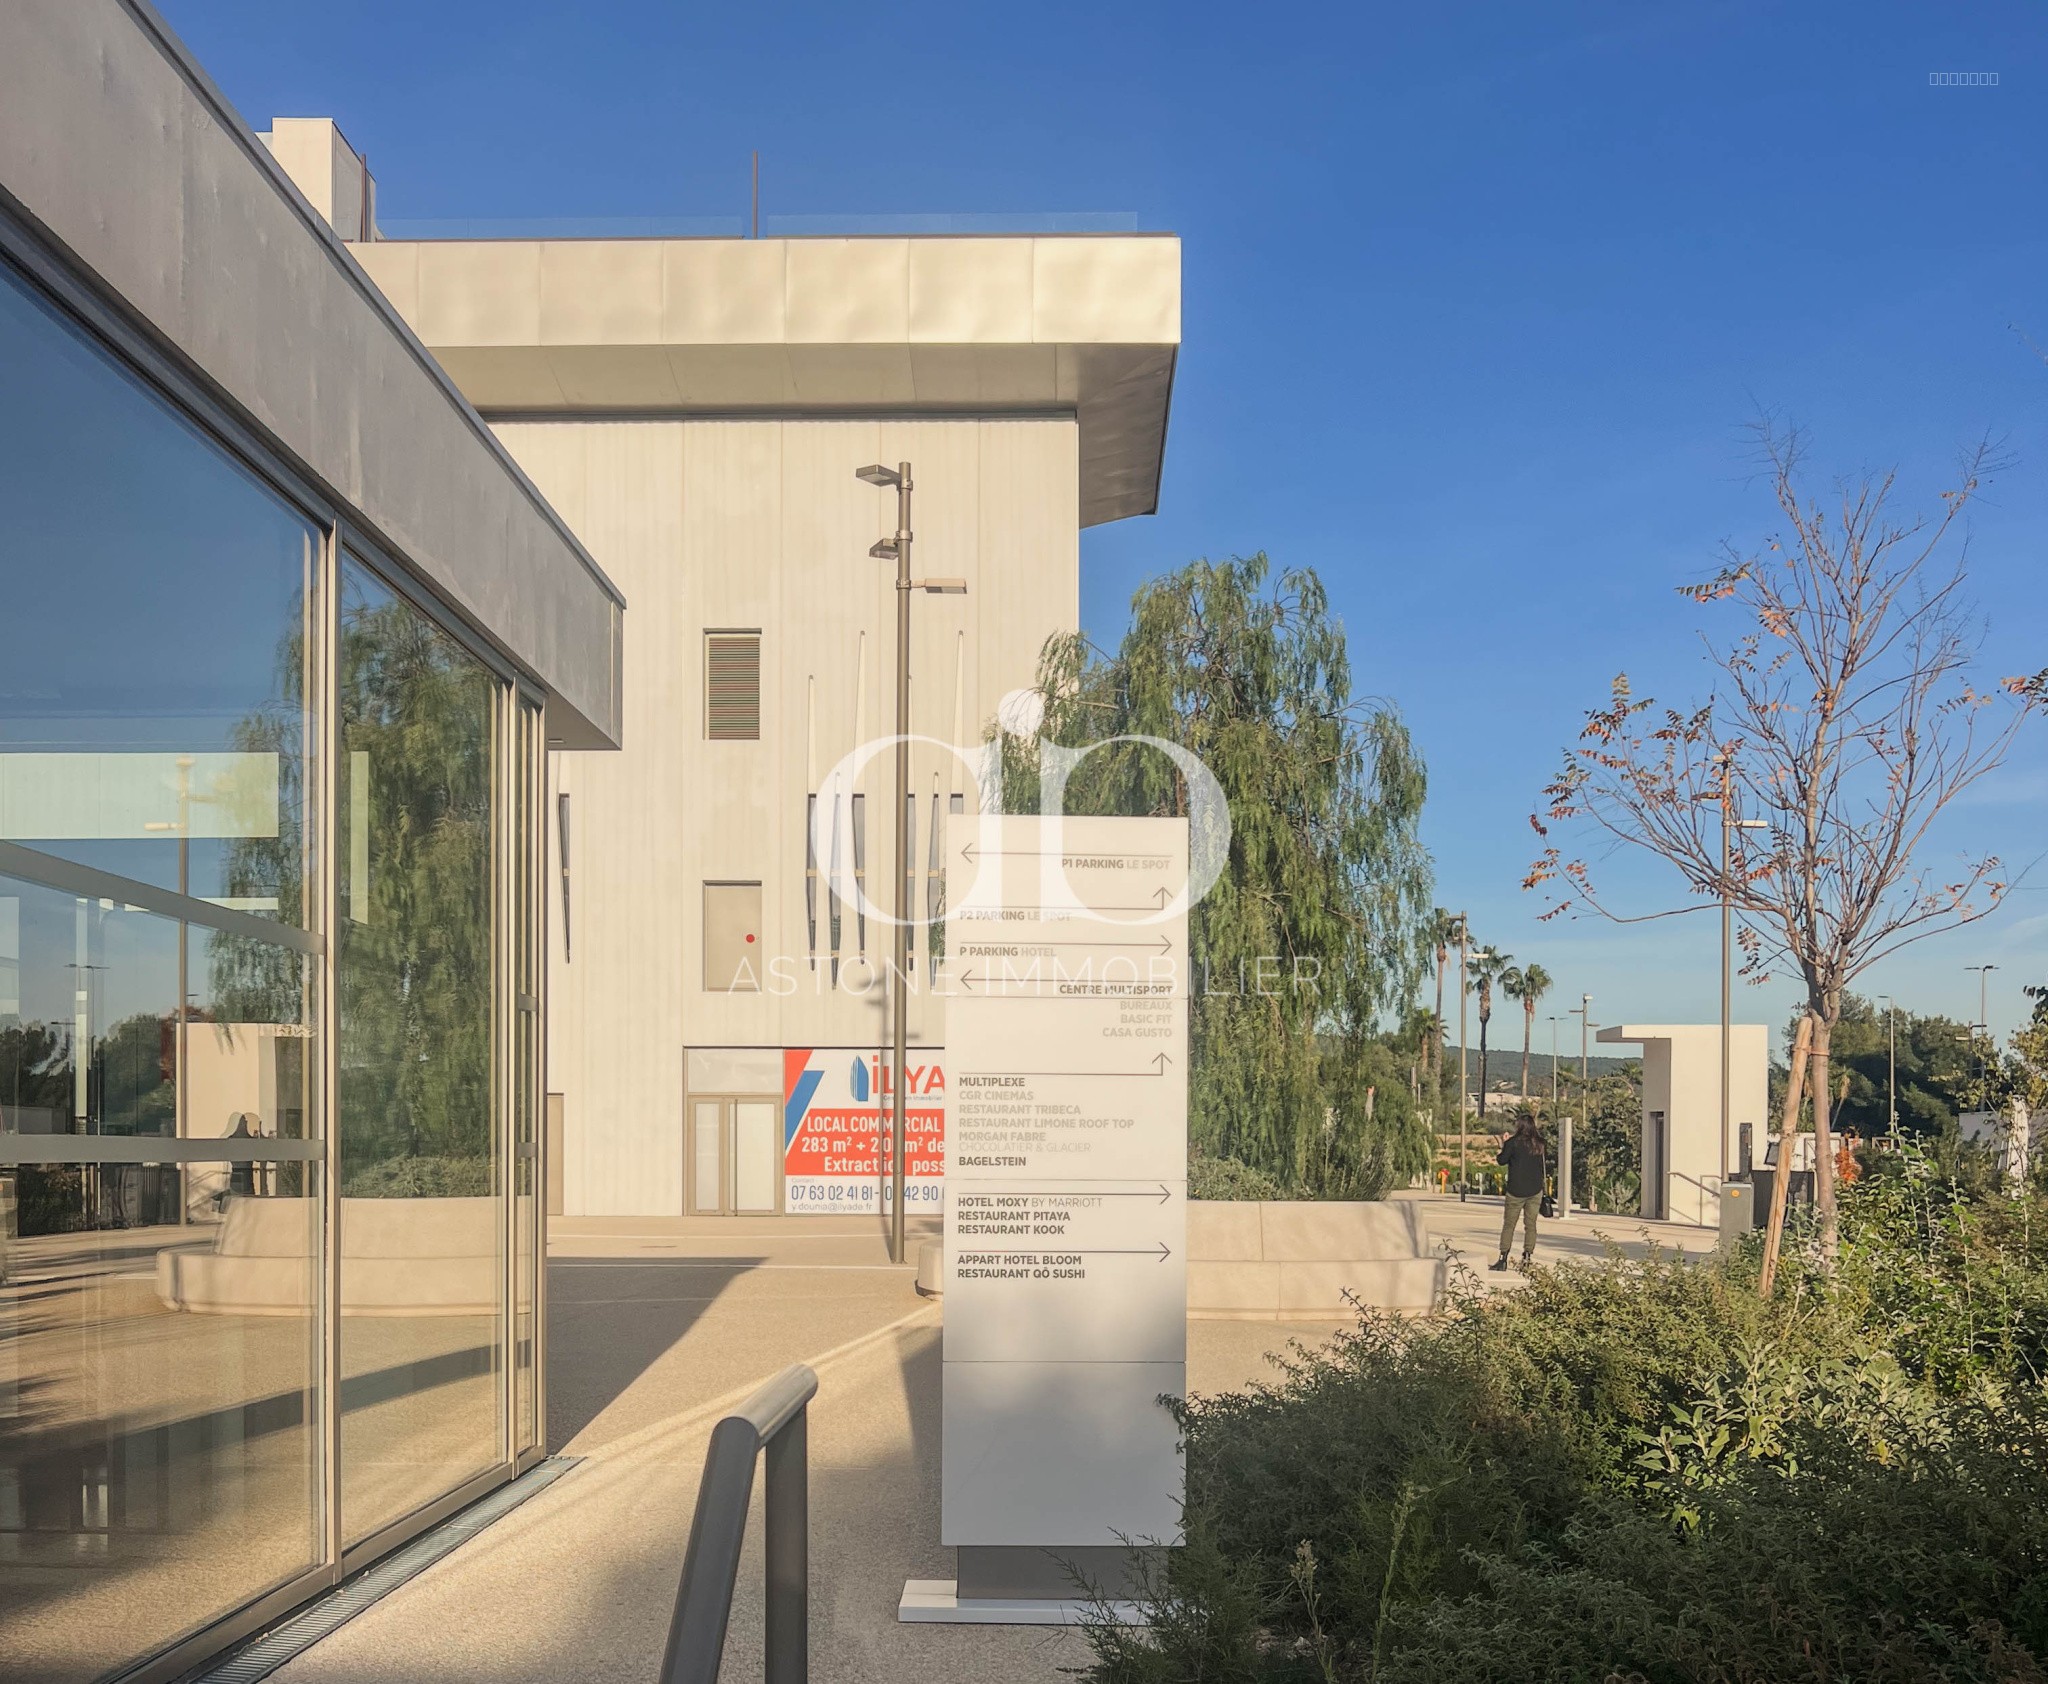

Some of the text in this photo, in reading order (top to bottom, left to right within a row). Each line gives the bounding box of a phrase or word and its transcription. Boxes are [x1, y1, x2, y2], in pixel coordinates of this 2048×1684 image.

[1062, 859, 1170, 869] P1 PARKING LE SPOT
[960, 911, 974, 921] P2
[976, 911, 1025, 921] PARKING
[1028, 911, 1040, 921] LE
[960, 947, 1057, 957] P PARKING HOTEL
[1060, 984, 1173, 995] CENTRE MULTISPORT
[1120, 1001, 1172, 1010] BUREAUX
[1121, 1014, 1172, 1024] BASIC FIT
[1103, 1028, 1172, 1038] CASA GUSTO
[959, 1077, 1025, 1087] MULTIPLEXE
[959, 1091, 1034, 1100] CGR CINEMAS
[959, 1105, 1081, 1114] RESTAURANT TRIBECA
[807, 1117, 941, 1133] LOCAL COMMRCIAL
[959, 1118, 1135, 1128] RESTAURANT LIMONE ROOF TOP
[959, 1132, 1046, 1141] MORGAN FABRE
[801, 1137, 828, 1153] 283
[959, 1142, 1032, 1152] CHOCOLATIER
[1046, 1142, 1091, 1152] GLACIER
[958, 1157, 1027, 1166] BAGELSTEIN
[791, 1185, 806, 1200] 07
[809, 1185, 824, 1200] 63
[828, 1185, 843, 1200] 02
[847, 1185, 858, 1200] 41
[861, 1185, 873, 1200] 81
[922, 1185, 938, 1200] 90
[958, 1198, 1103, 1207] HOTEL MOXY BY MARRIOTT
[958, 1211, 1071, 1221] RESTAURANT PITAYA
[958, 1225, 1065, 1234] RESTAURANT KOOK
[958, 1256, 1082, 1265] APPART HOTEL BLOOM
[958, 1269, 1030, 1279] RESTAURANT
[1053, 1269, 1085, 1279] SUSHI
